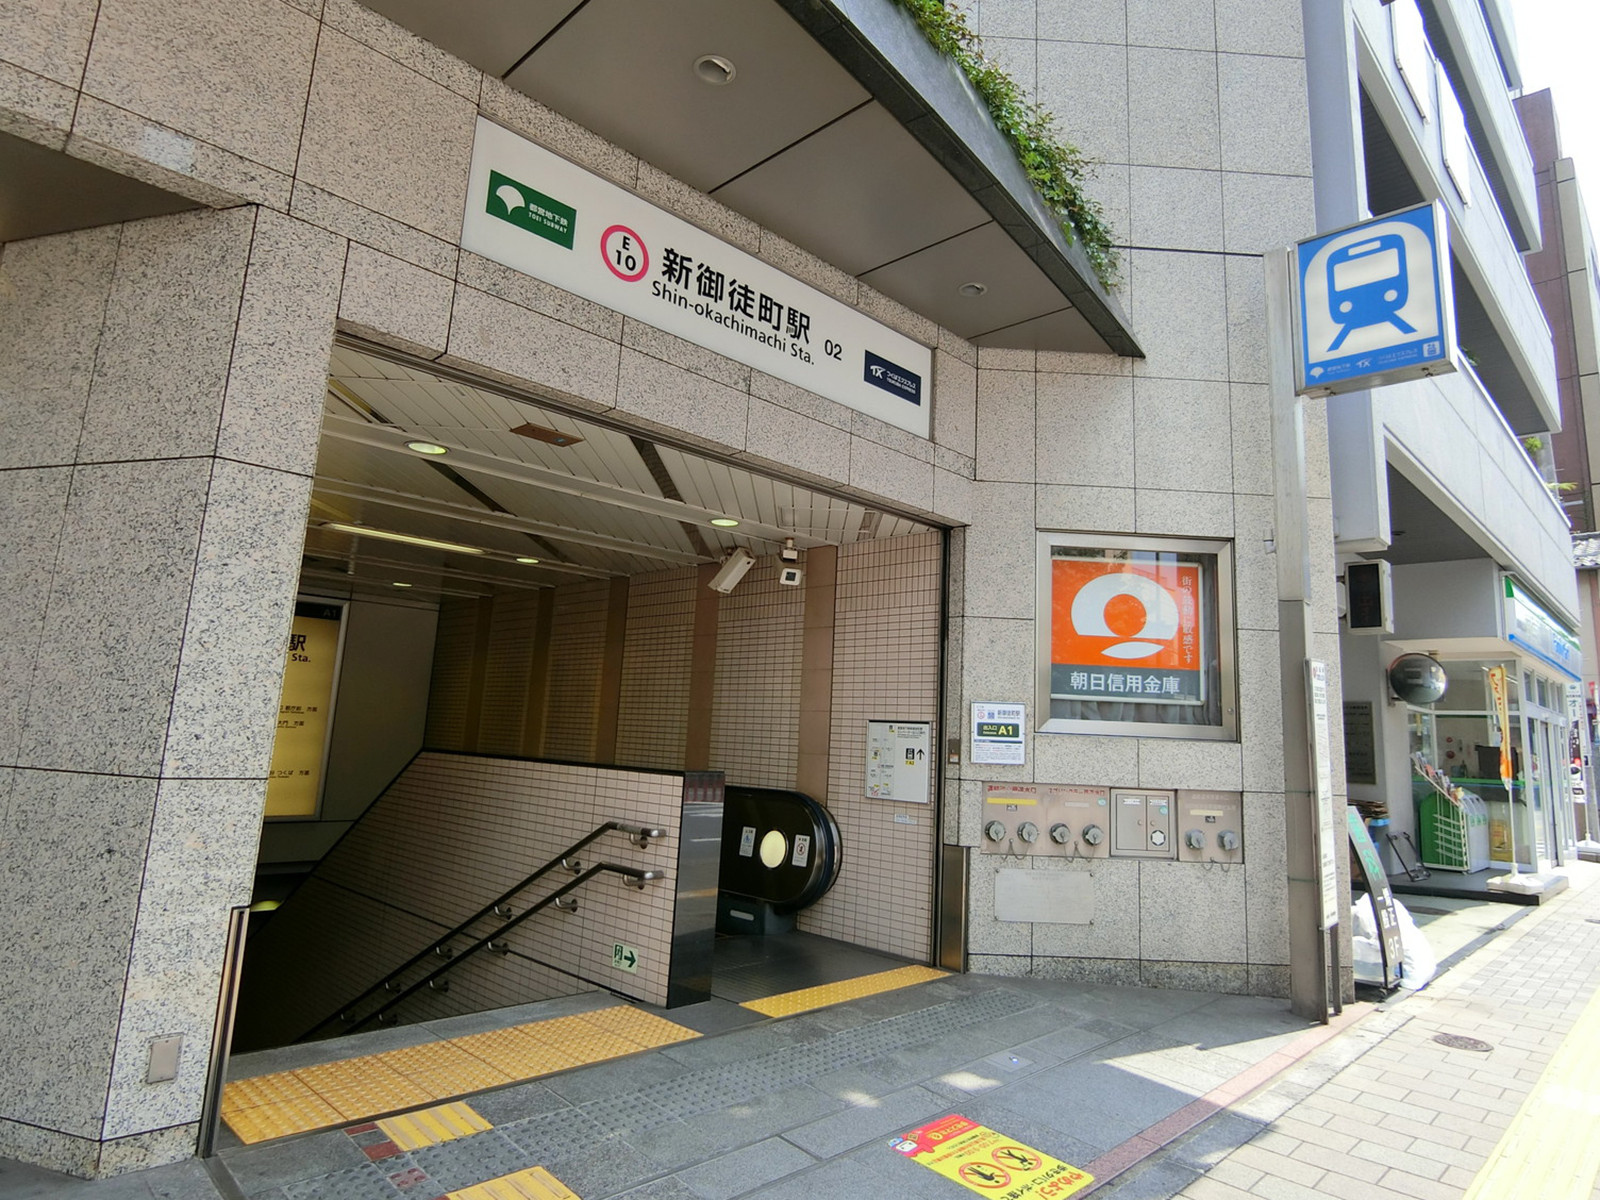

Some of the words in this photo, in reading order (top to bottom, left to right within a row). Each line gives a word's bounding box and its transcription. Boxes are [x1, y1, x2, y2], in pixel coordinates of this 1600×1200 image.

[528, 211, 542, 222] TOEI
[543, 218, 568, 234] SUBWAY
[529, 202, 568, 228] 都営地下鉄
[622, 235, 631, 251] E
[616, 249, 636, 271] 10
[661, 247, 810, 344] 新御徒町駅
[652, 280, 786, 352] Shin-okachimachi
[790, 342, 814, 365] Sta.
[824, 339, 843, 361] 02
[870, 365, 886, 380] TX
[292, 653, 311, 662] Sta.
[1069, 671, 1181, 695] 朝日信用金庫
[998, 725, 1013, 735] A1
